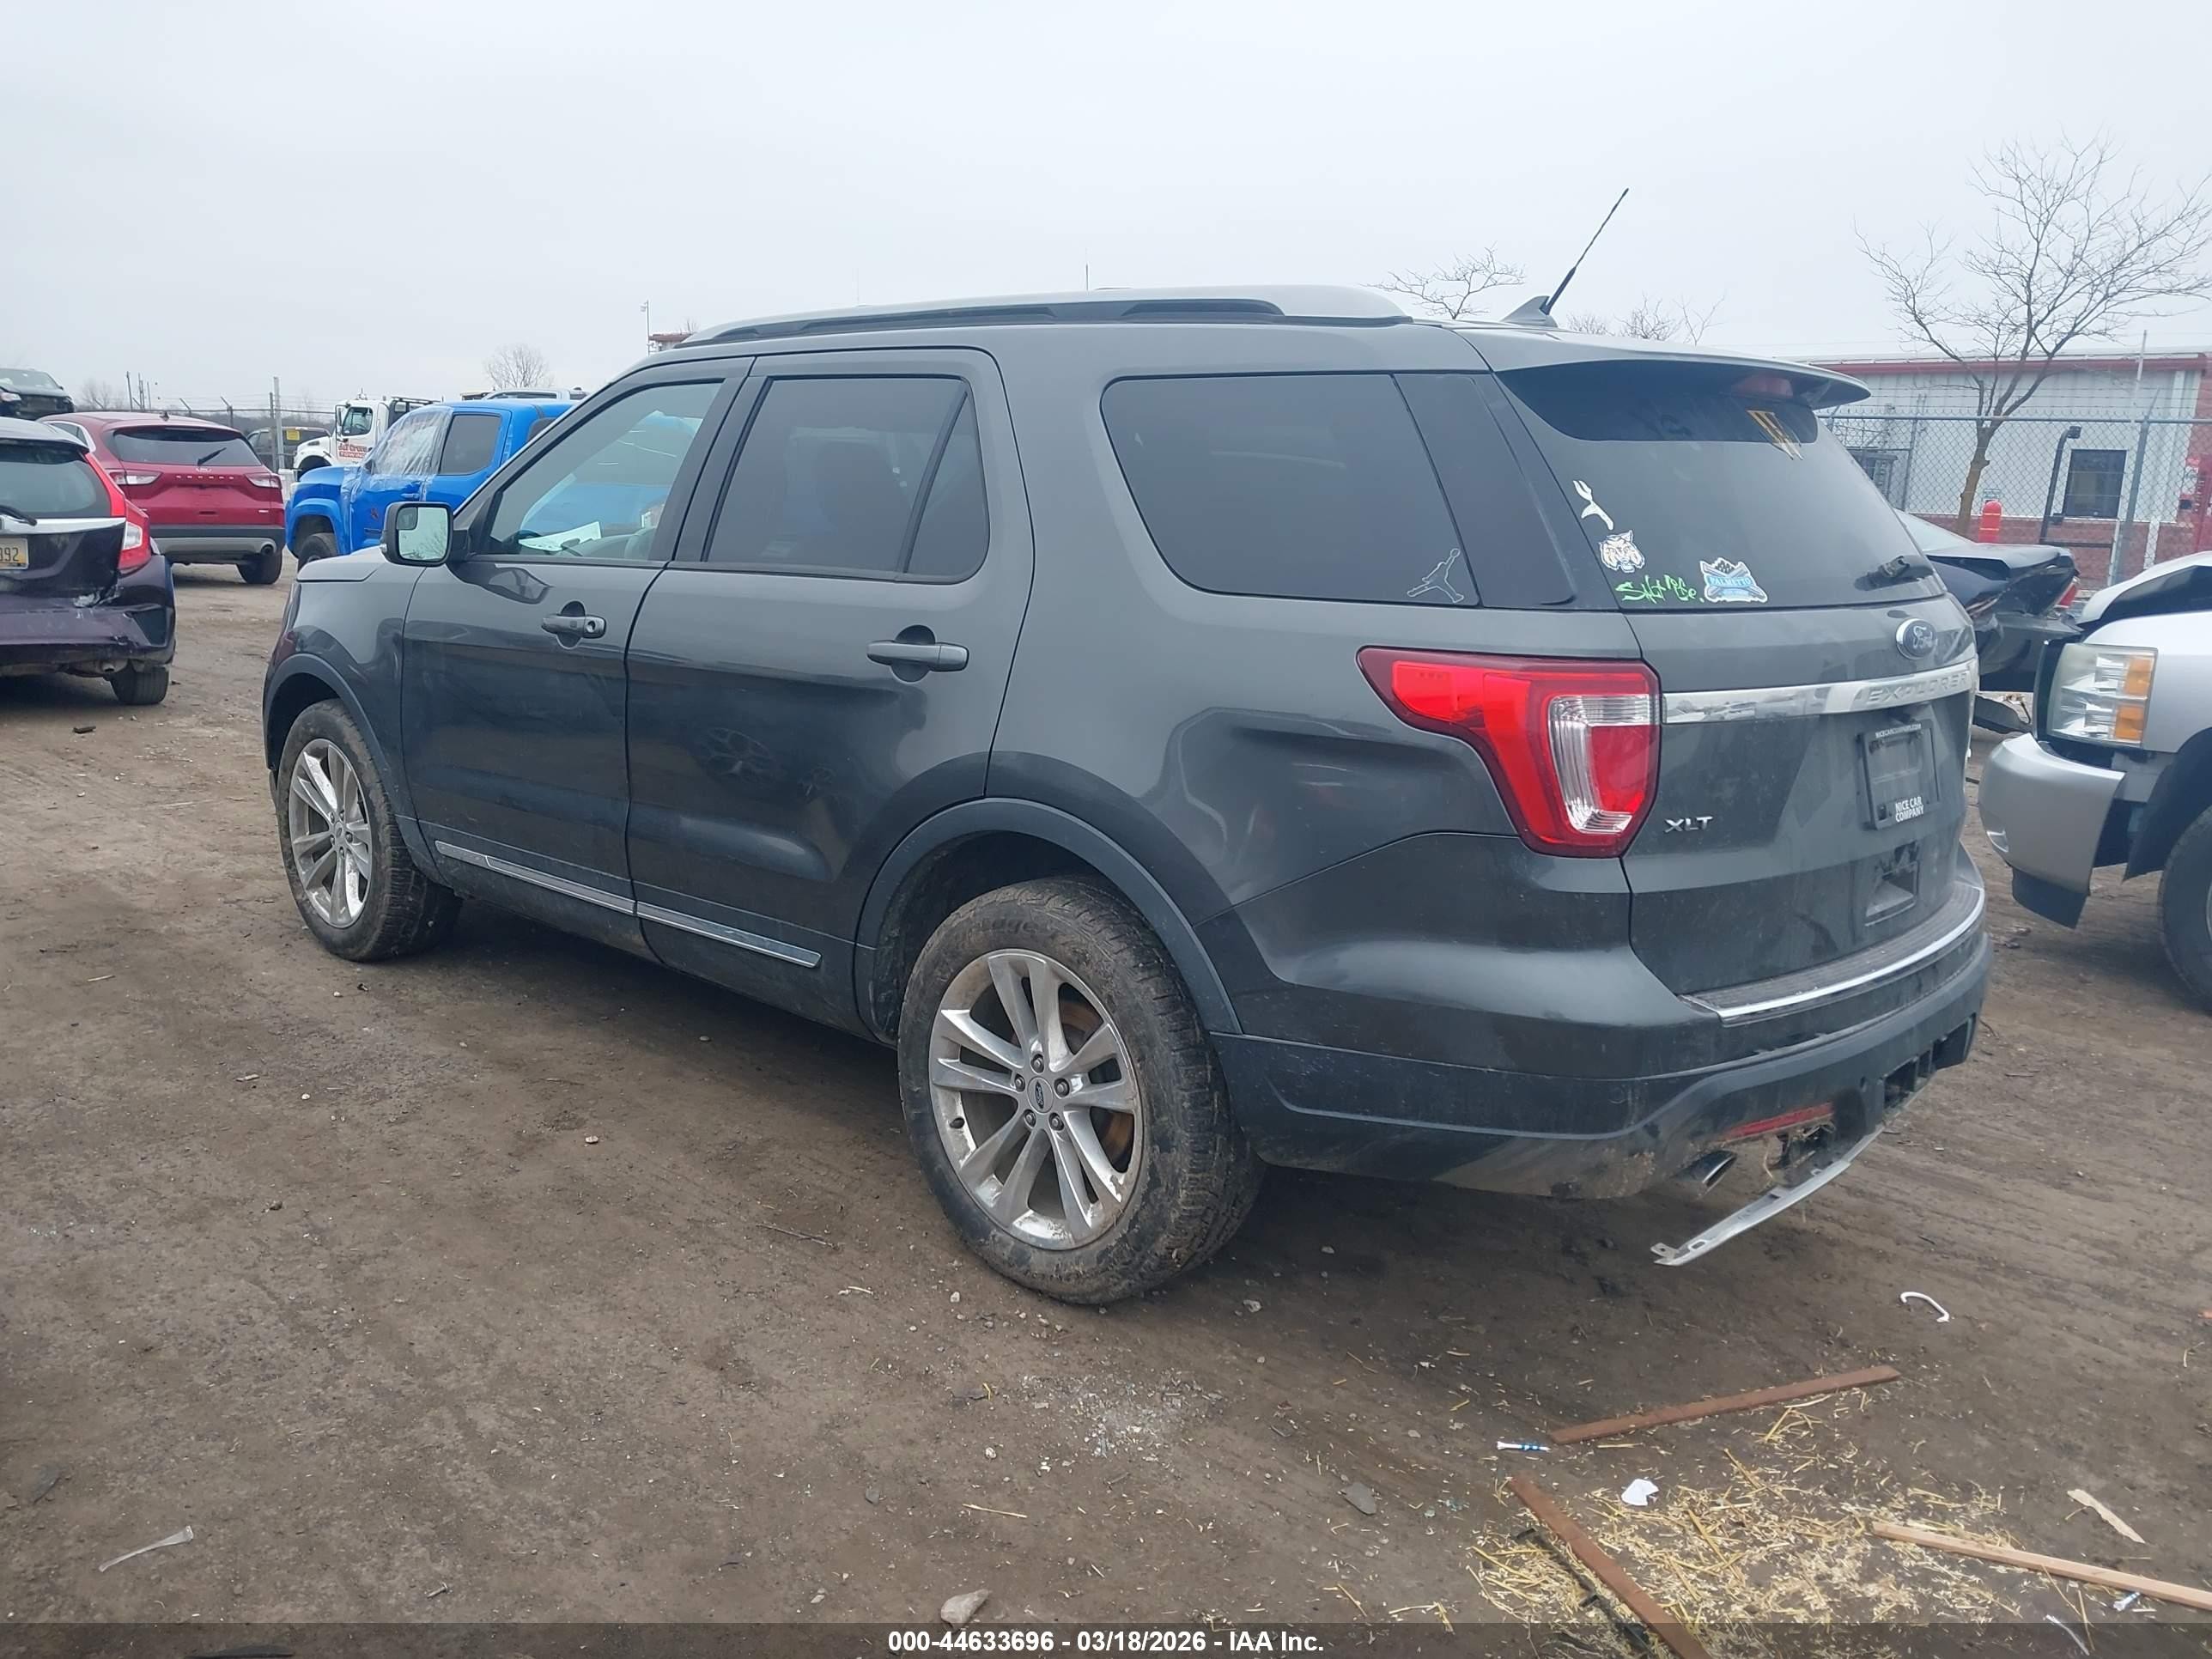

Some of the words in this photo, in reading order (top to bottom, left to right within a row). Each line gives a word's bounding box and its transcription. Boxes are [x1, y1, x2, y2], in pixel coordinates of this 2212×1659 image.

[1708, 576, 1752, 586] PALMETTO
[1867, 670, 1971, 703] EXPLORER
[1895, 799, 1909, 812] NICE
[1909, 797, 1923, 808] CAR
[1895, 805, 1924, 823] COMPANY
[1665, 816, 1713, 833] XLT
